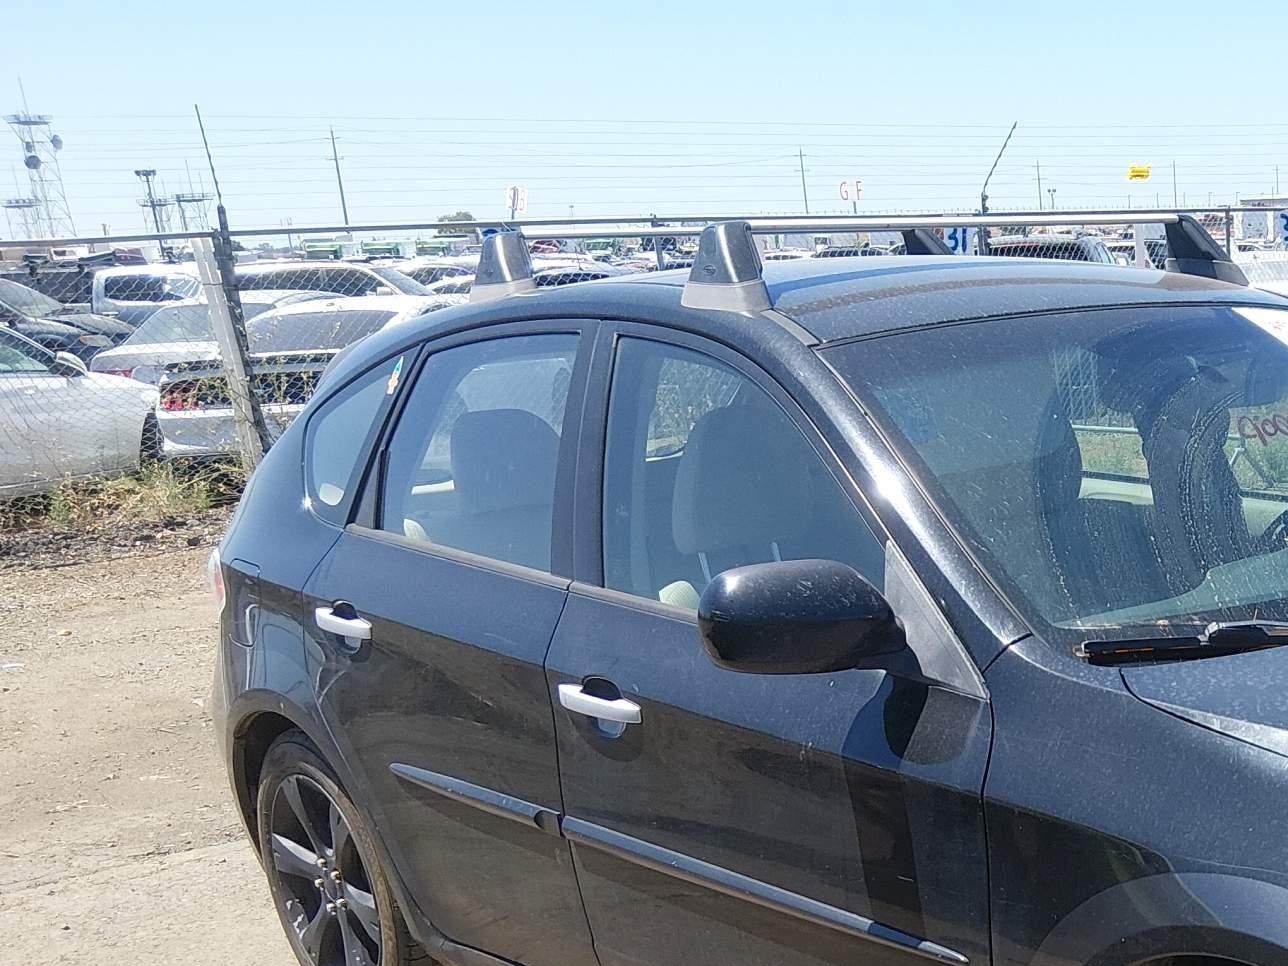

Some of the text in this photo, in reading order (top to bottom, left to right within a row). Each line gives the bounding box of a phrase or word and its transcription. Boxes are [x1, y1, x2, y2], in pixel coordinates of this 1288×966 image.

[839, 180, 864, 201] G F
[947, 226, 968, 253] 31
